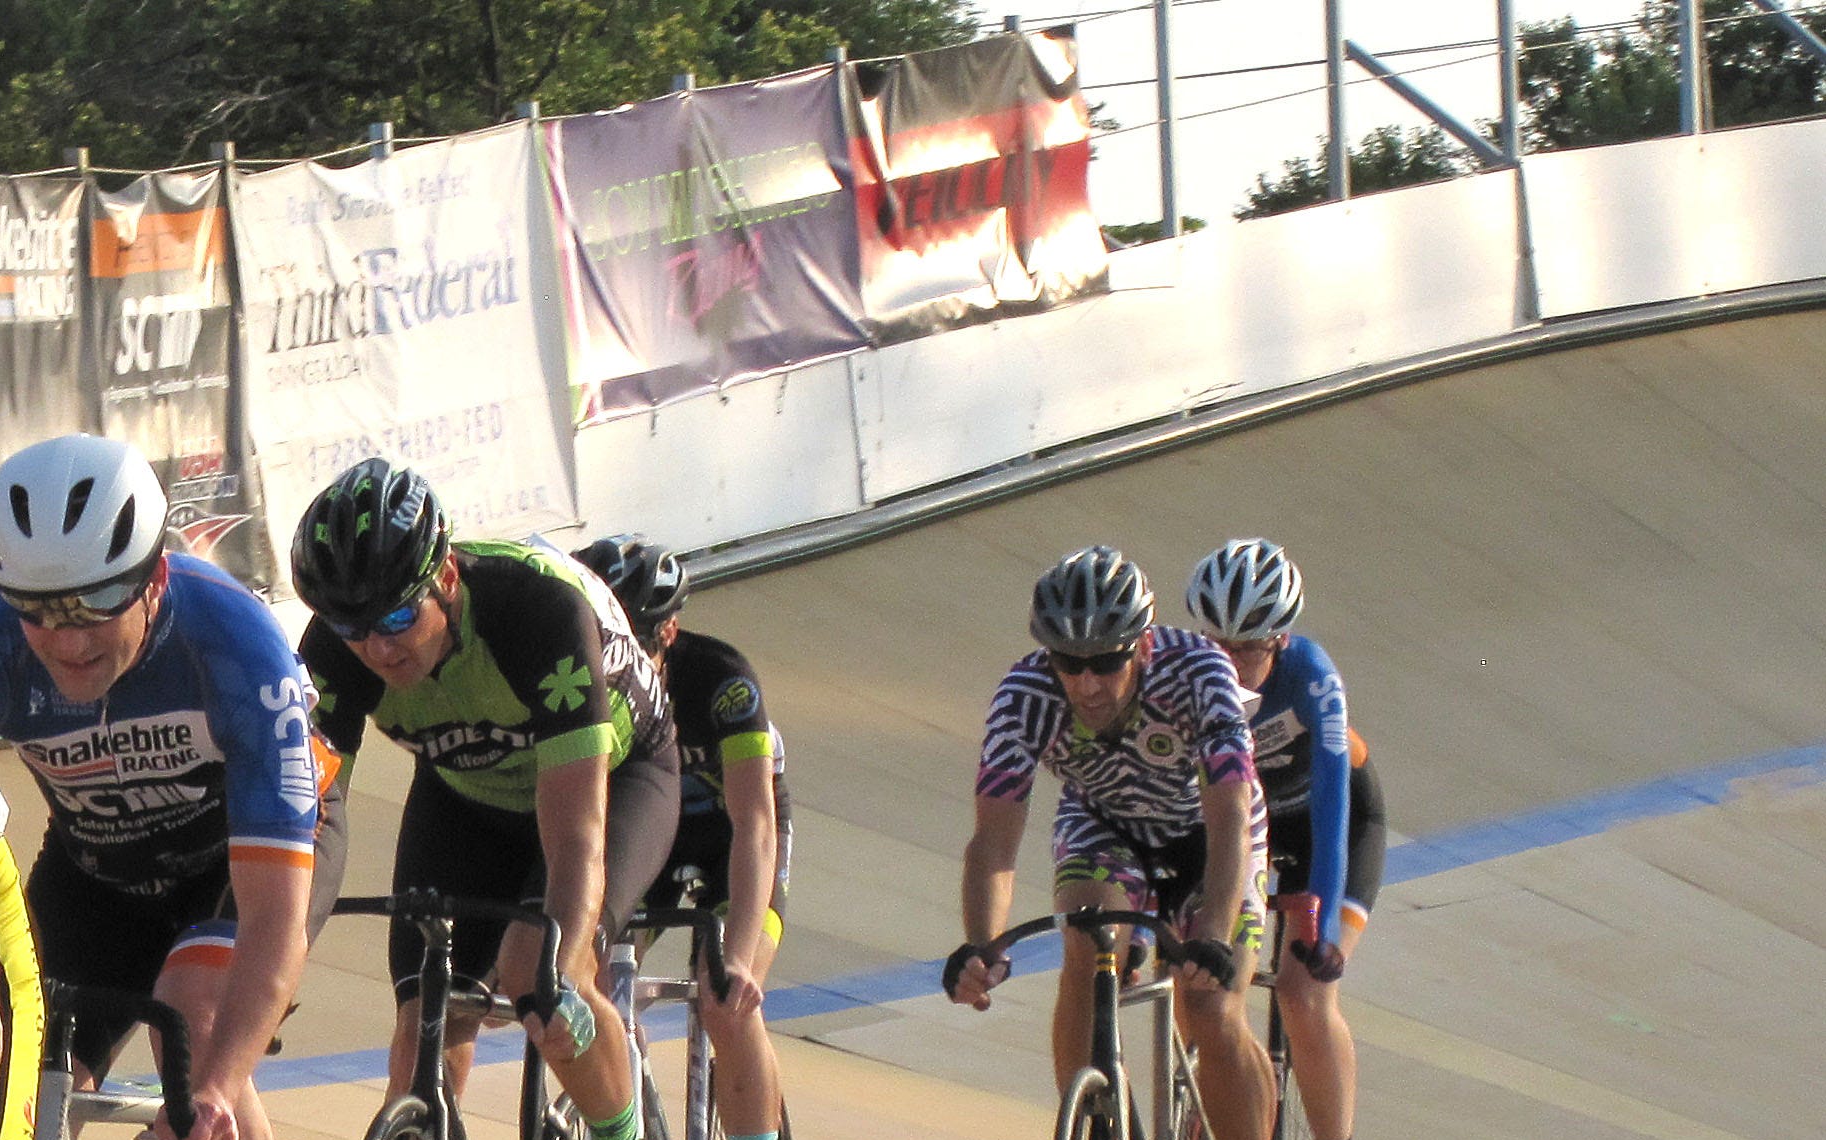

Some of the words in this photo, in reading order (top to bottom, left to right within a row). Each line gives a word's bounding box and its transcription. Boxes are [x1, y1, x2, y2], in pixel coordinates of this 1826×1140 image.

[22, 721, 193, 770] Snakebite
[122, 748, 201, 774] RACING
[76, 816, 115, 831] Safety
[163, 798, 221, 832] Training
